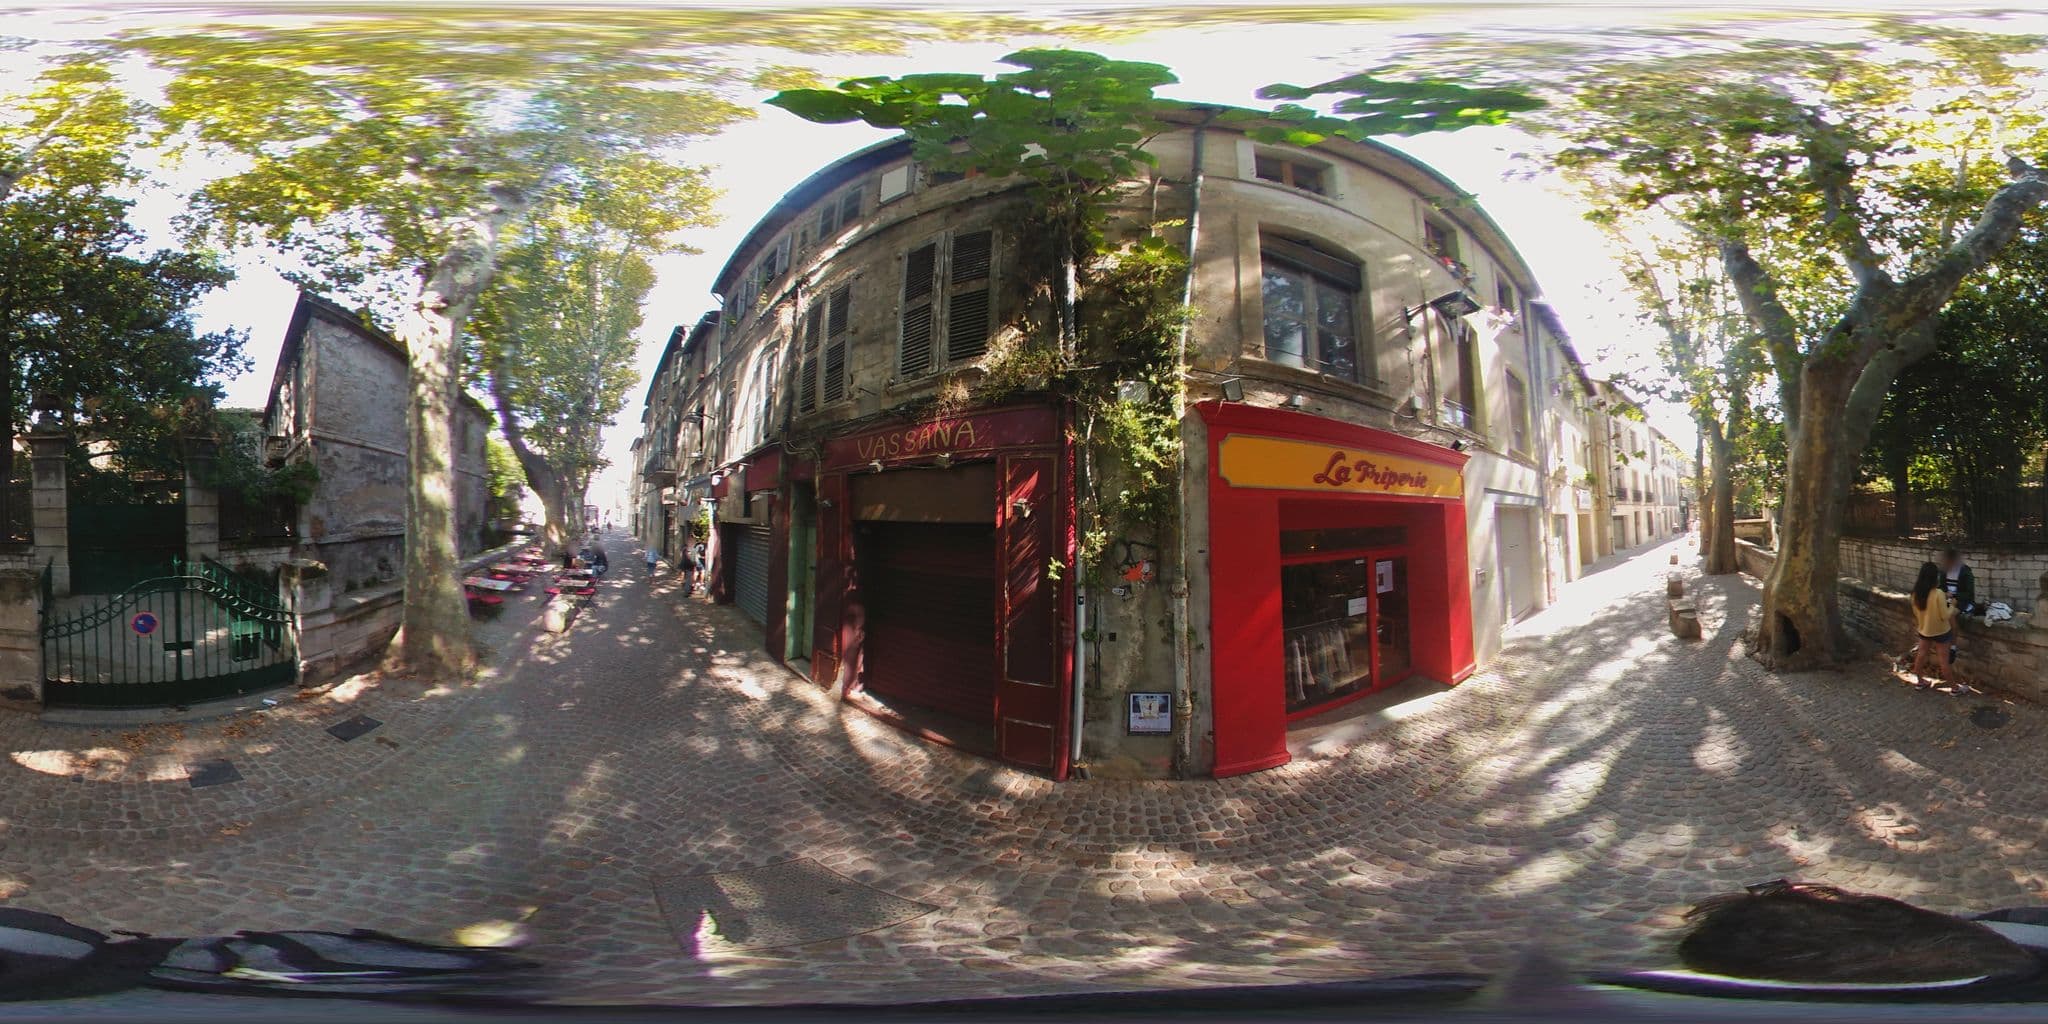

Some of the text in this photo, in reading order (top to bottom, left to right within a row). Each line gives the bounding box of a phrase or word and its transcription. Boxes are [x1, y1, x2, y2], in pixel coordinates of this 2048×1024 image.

[857, 420, 976, 459] VASSANA
[1313, 451, 1428, 490] La Friperie
